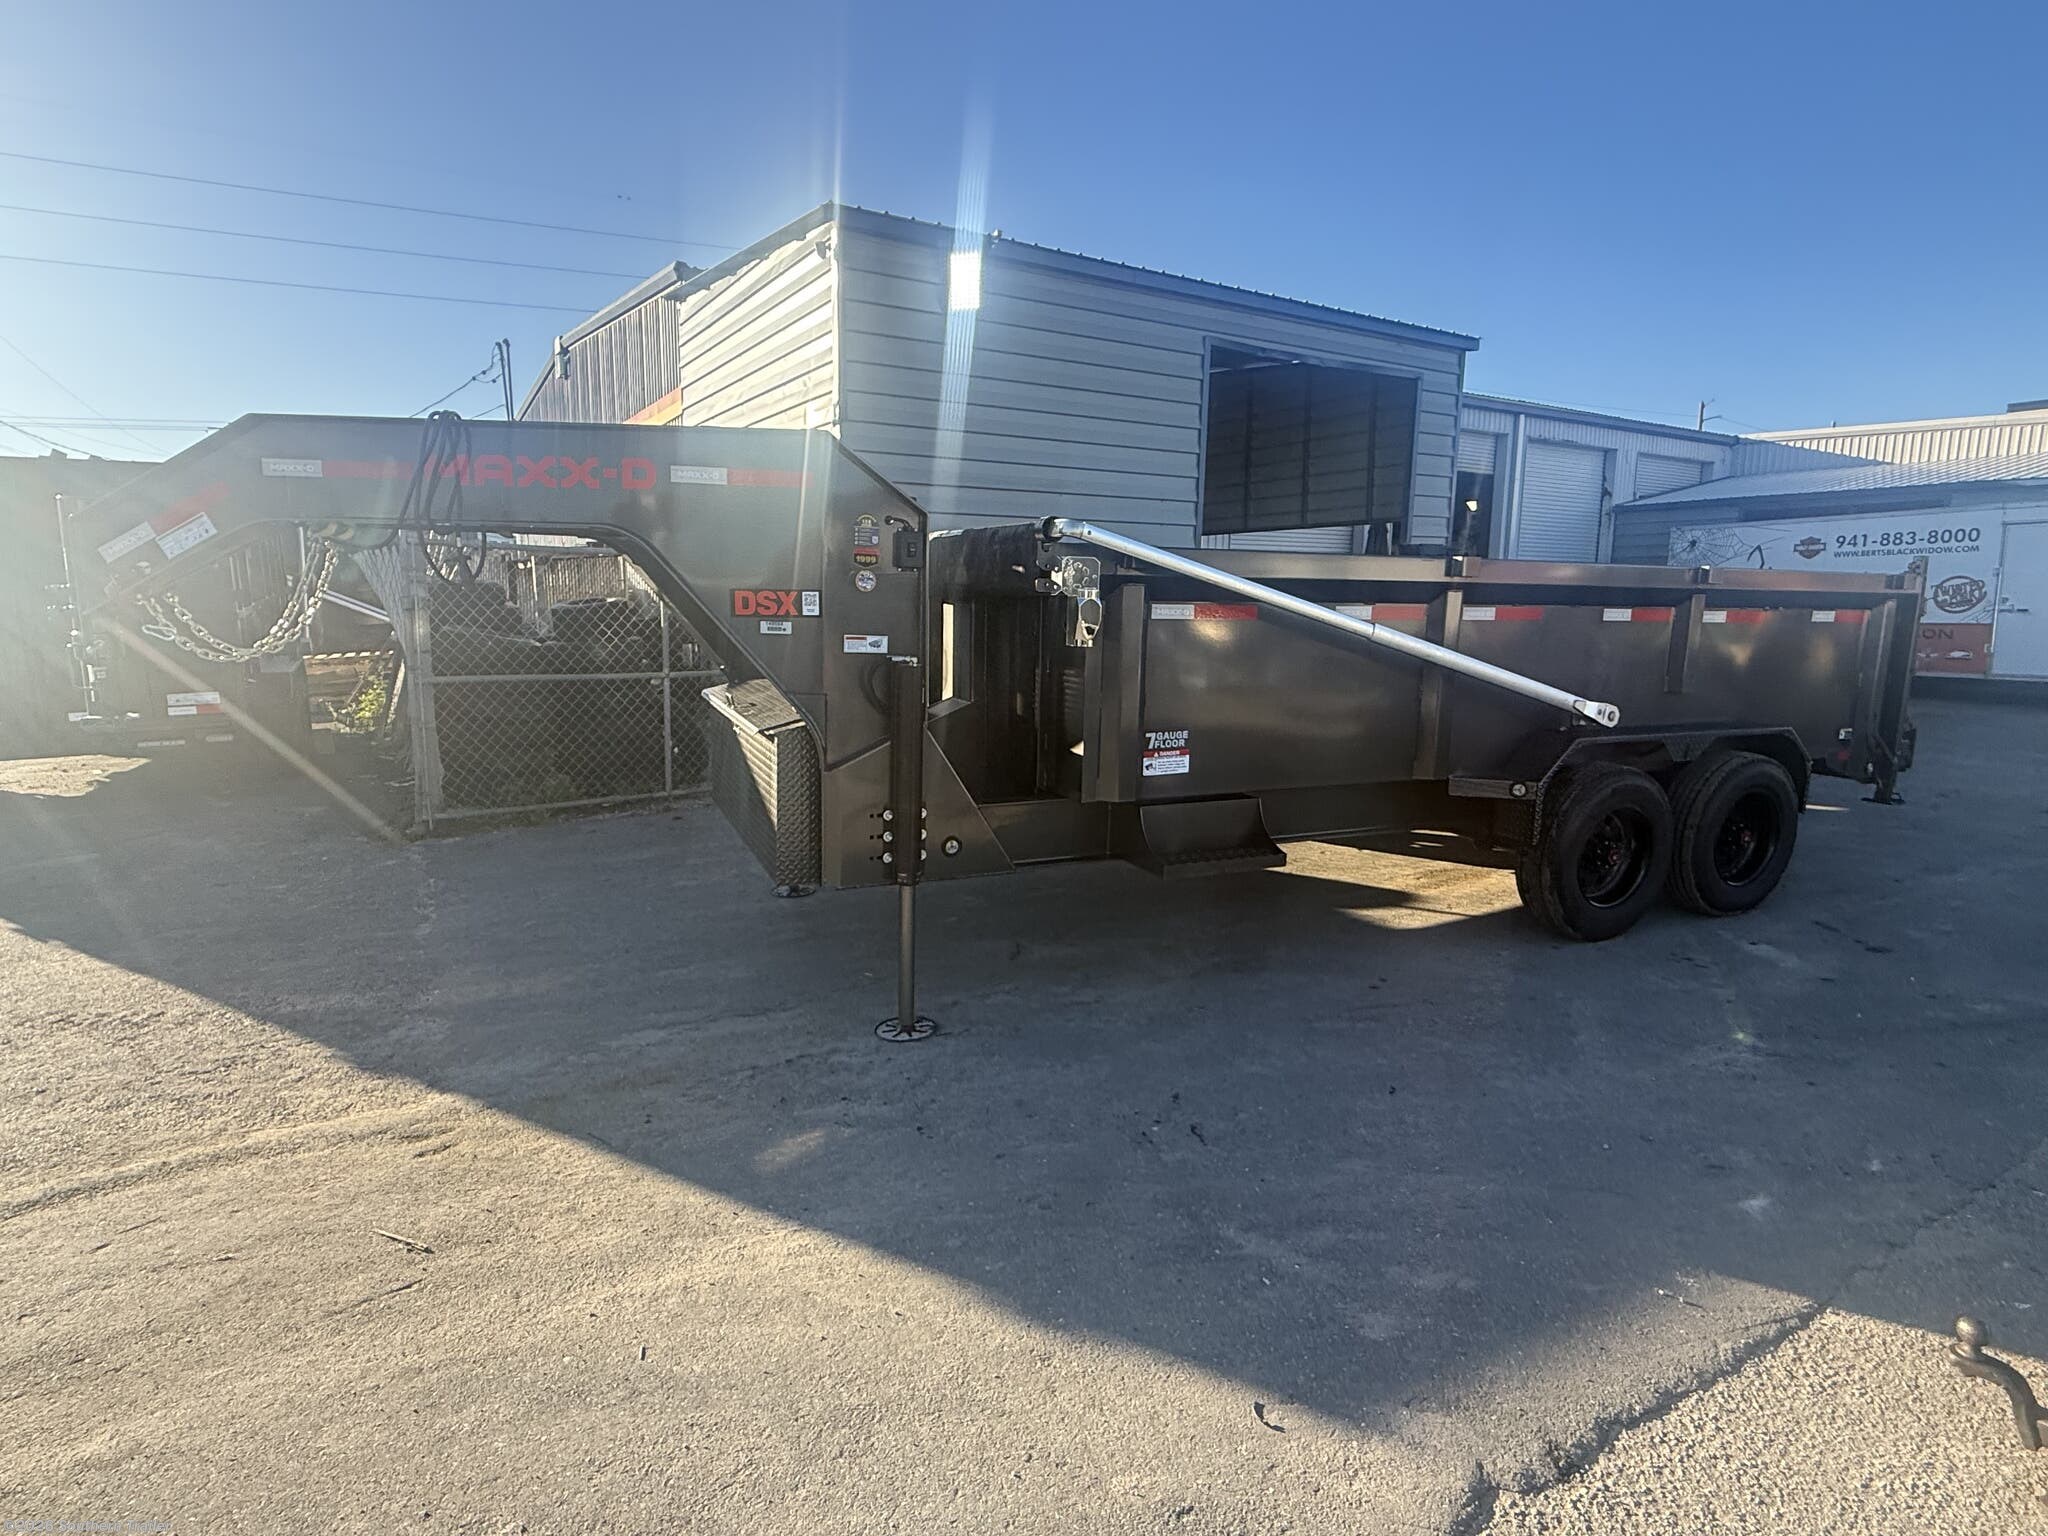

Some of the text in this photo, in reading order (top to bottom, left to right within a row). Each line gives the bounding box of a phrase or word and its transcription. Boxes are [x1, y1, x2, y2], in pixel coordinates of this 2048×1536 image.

[424, 454, 657, 489] MAXX-D
[678, 470, 720, 480] MAXX-D
[1835, 527, 1981, 549] 941-883-8000
[1833, 545, 1980, 558] WWW.BERTSBLACKWIDOW.COM
[735, 590, 799, 616] DSX
[1145, 730, 1189, 749] 7 GAUGE
[1155, 739, 1185, 749] FLOOR
